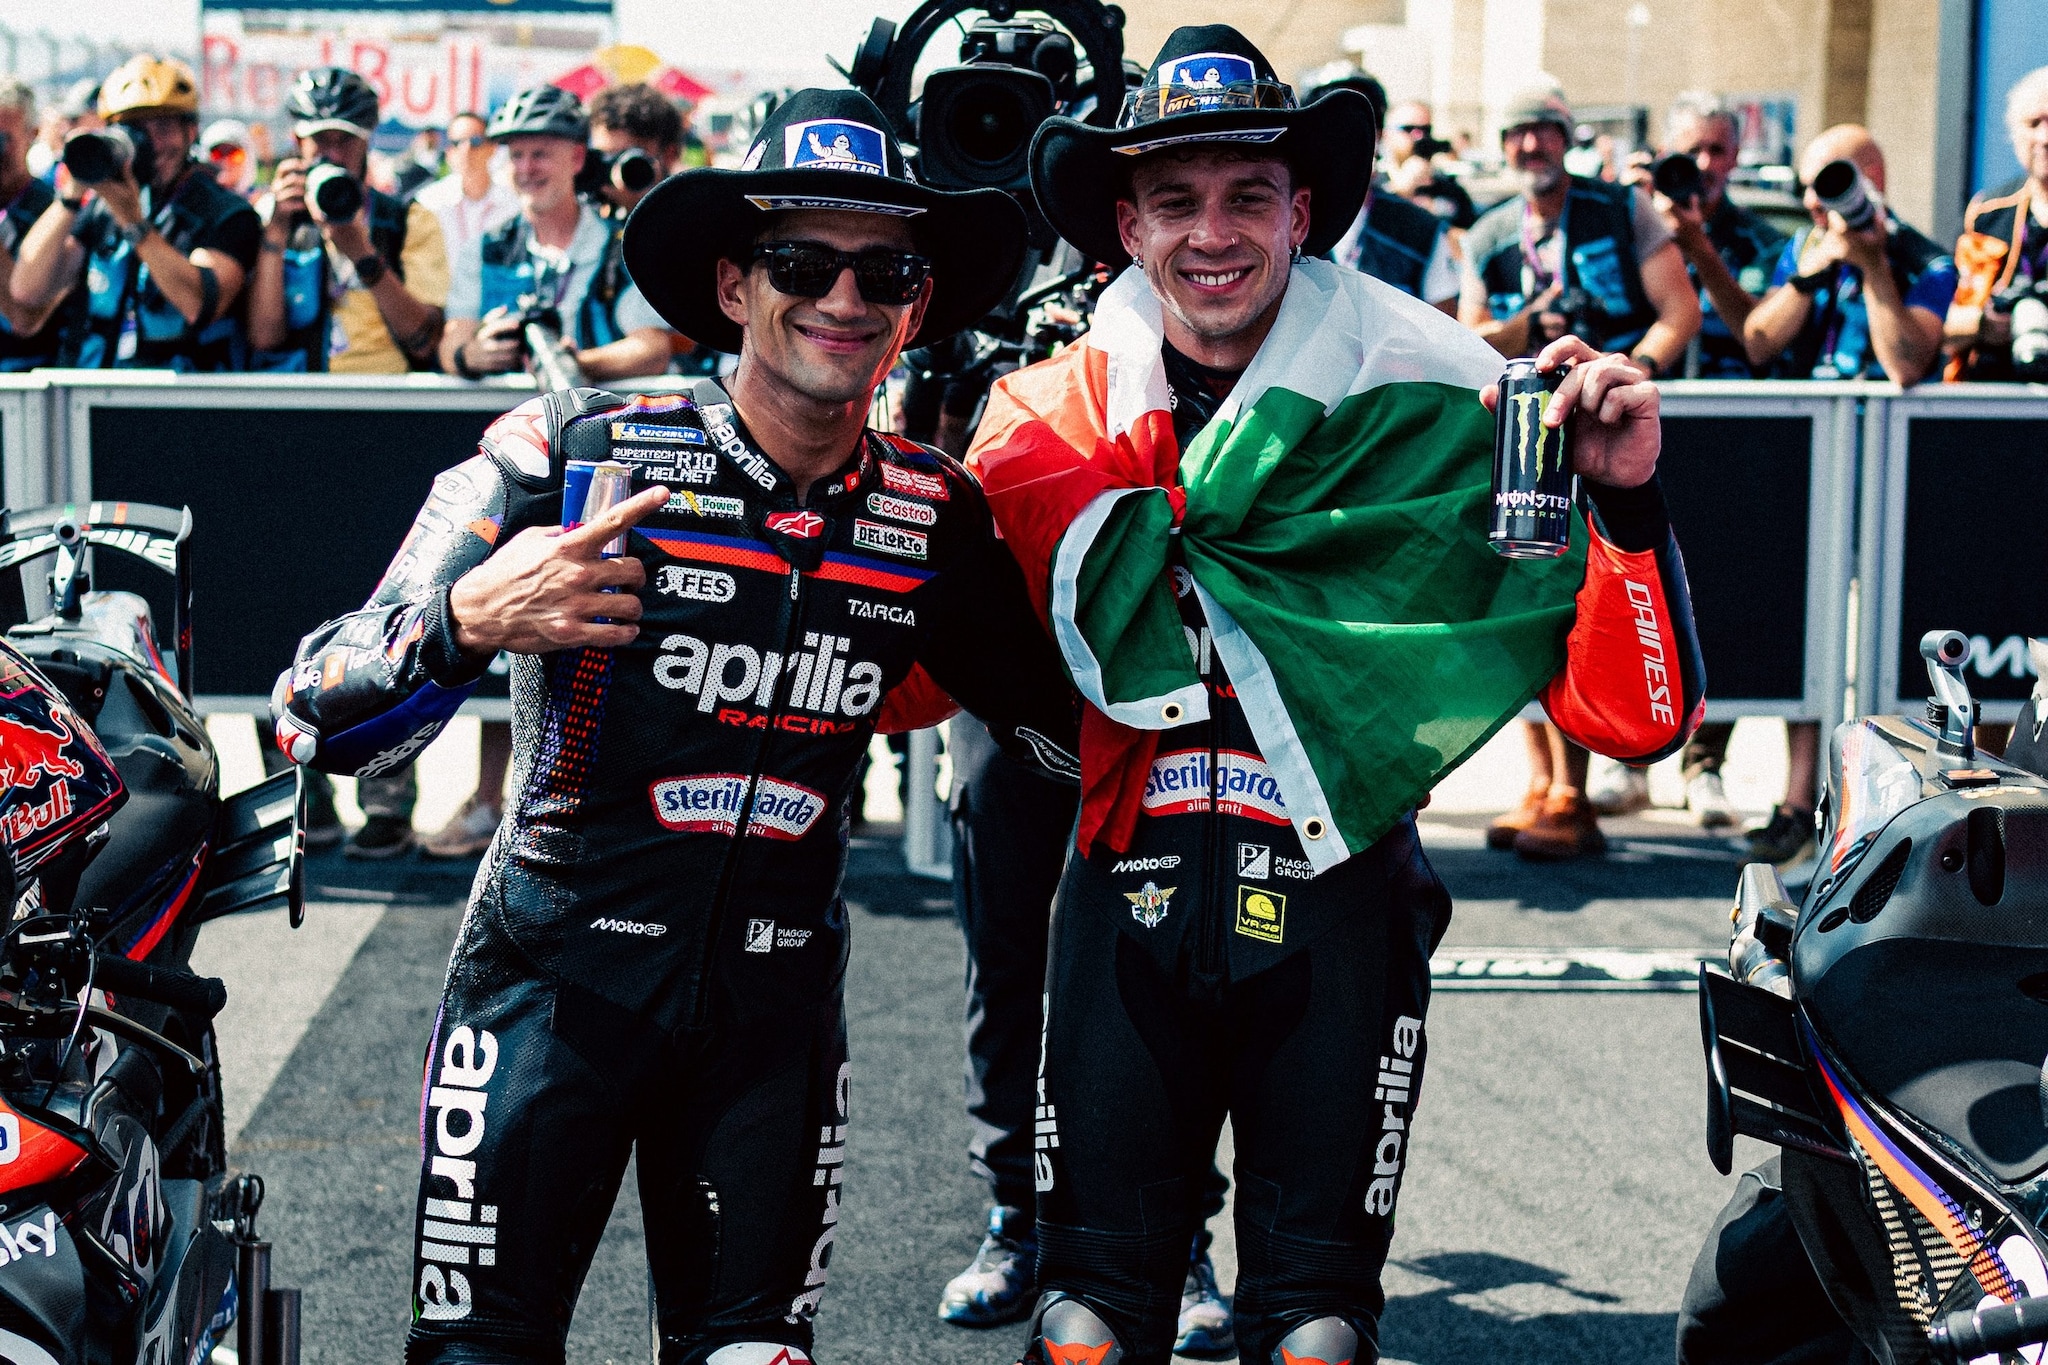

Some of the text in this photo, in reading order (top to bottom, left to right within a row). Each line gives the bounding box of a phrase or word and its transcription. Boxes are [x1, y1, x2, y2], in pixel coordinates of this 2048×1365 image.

[352, 38, 482, 116] Bull
[1166, 94, 1251, 113] MICHELIN
[805, 162, 880, 175] CHELIN
[638, 430, 698, 439] MICHELIN
[612, 447, 718, 471] SUPERTECH R10
[714, 422, 778, 491] aprilia
[644, 466, 718, 484] HELMET
[702, 498, 740, 511] Power
[882, 500, 933, 522] Castrol
[1504, 509, 1565, 520] ENERGY
[847, 599, 916, 626] TARGA
[1624, 578, 1676, 726] DAINESE
[653, 630, 882, 717] aprilia
[9, 777, 73, 845] Bull
[1187, 799, 1243, 815] alimenti
[711, 821, 767, 837] alimnti
[1111, 855, 1181, 873] MotoGP
[1275, 856, 1314, 871] PIAGG
[1275, 866, 1317, 880] GROUP
[590, 917, 667, 936] MotoGP
[777, 928, 812, 938] PIAGGIO
[776, 938, 806, 947] GROUP
[1034, 991, 1060, 1192] rilia
[1364, 1015, 1423, 1217] aprilia
[421, 1025, 499, 1320] aprilia
